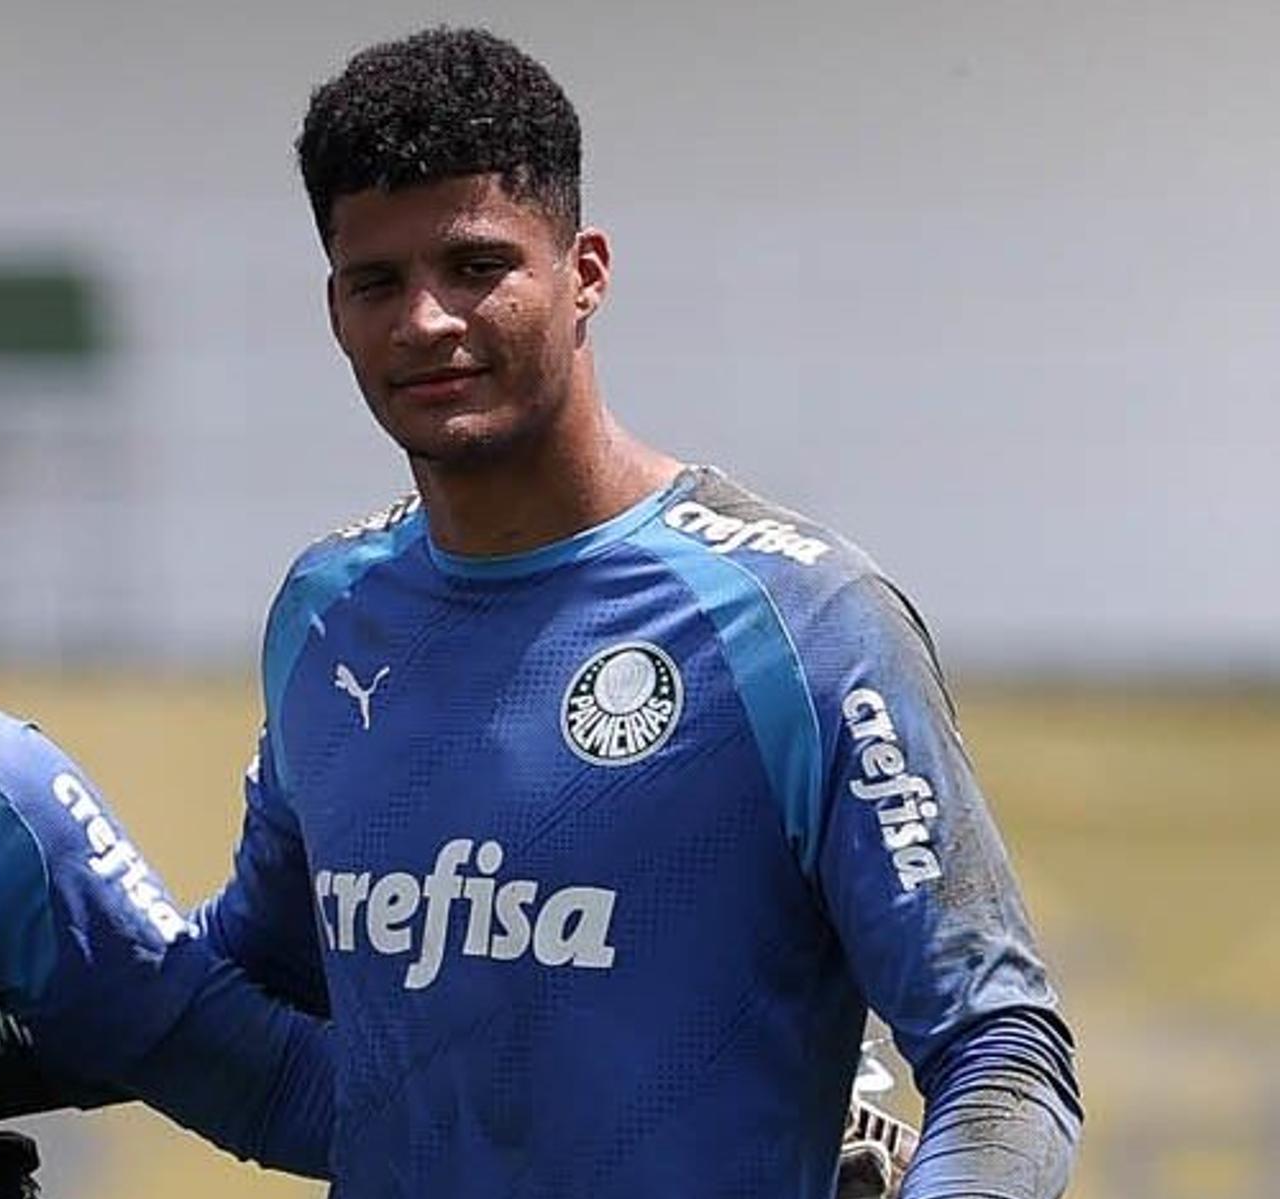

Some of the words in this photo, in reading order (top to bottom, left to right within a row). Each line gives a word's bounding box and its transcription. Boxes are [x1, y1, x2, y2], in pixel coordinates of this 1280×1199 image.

[665, 501, 832, 565] crefisa
[569, 695, 674, 759] PALMEIRAS
[842, 688, 941, 892] crefisa
[52, 773, 187, 942] crefisa
